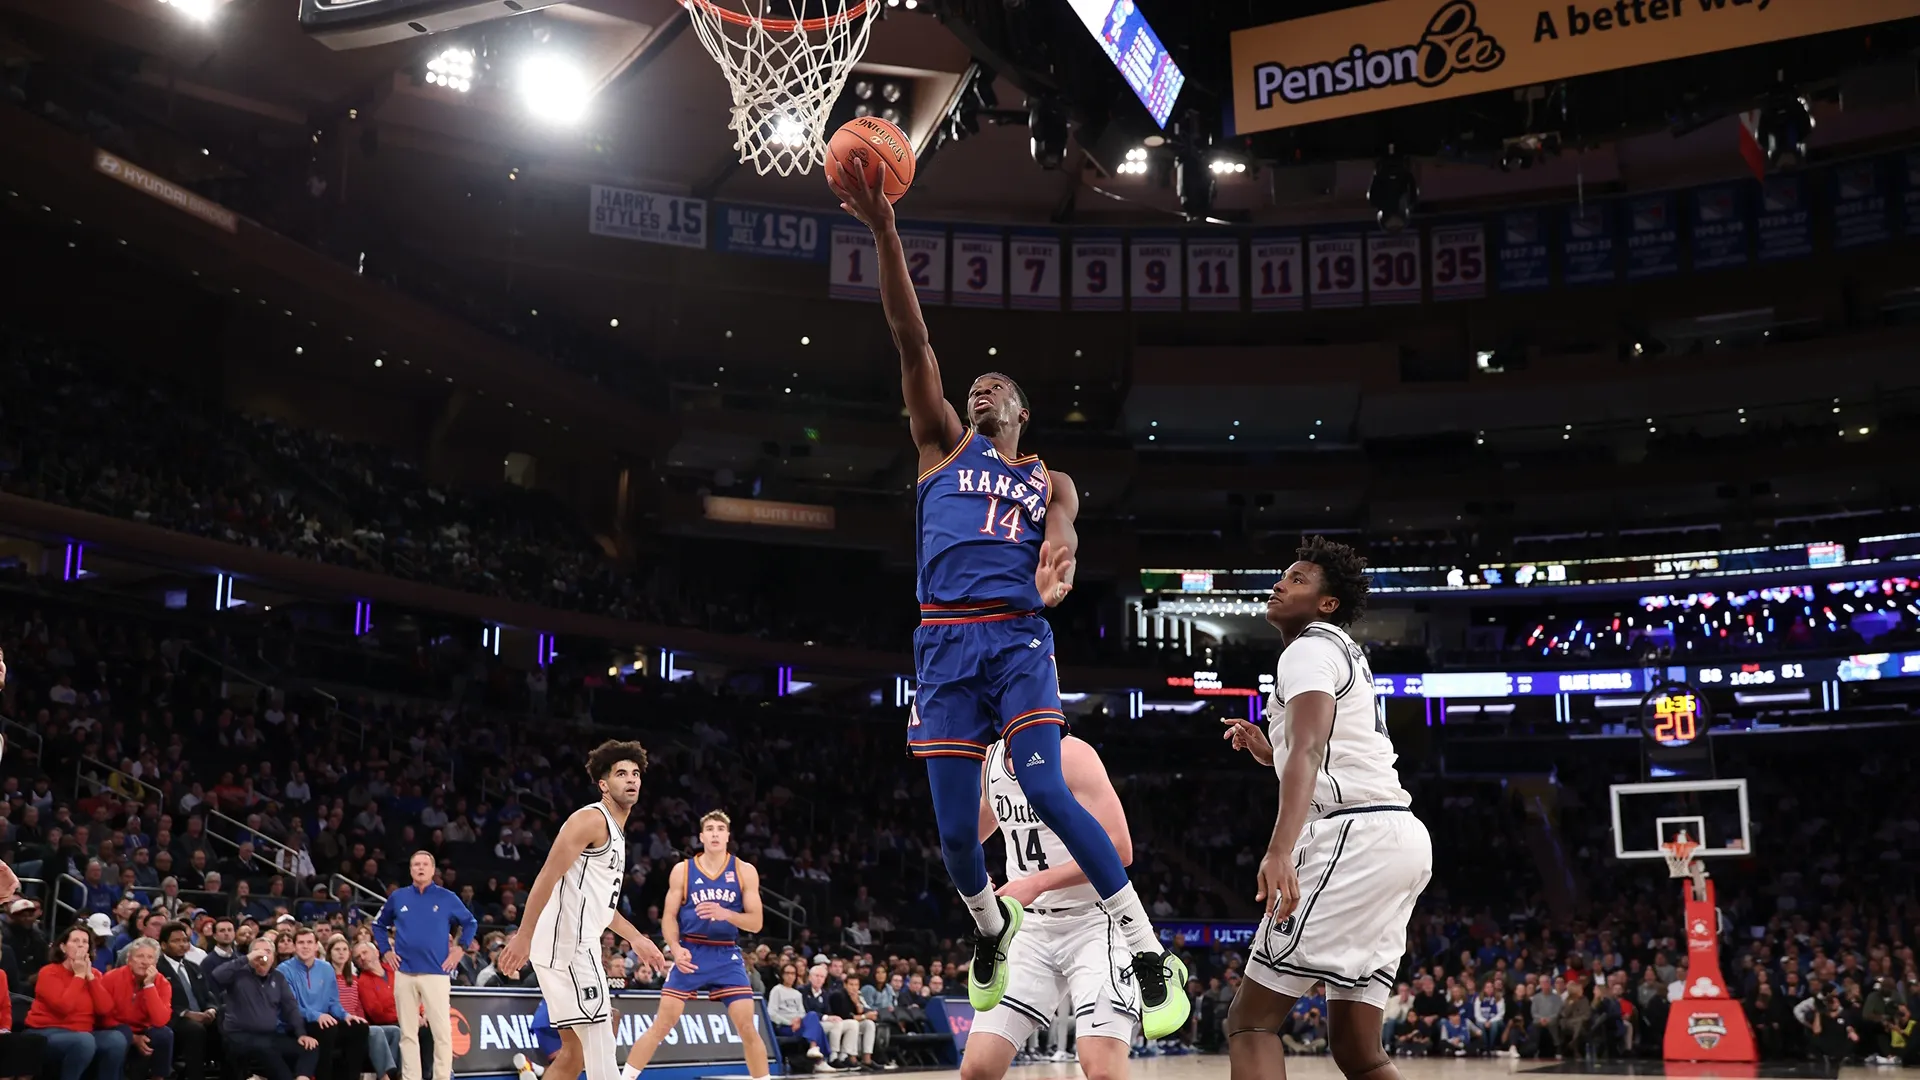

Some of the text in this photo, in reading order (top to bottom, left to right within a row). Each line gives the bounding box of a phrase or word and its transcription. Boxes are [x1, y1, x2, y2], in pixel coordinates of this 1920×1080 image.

[1533, 0, 1682, 43] A better
[1255, 1, 1504, 108] PensionBee
[856, 119, 906, 163] SPALDING
[124, 167, 187, 206] HYUNDAI
[600, 188, 656, 211] HARRY
[596, 206, 661, 230] STYLES
[667, 200, 701, 234] 15
[762, 213, 818, 251] 150
[848, 249, 863, 283] 1
[909, 252, 930, 286] 2
[967, 256, 988, 290] 3
[1024, 258, 1045, 293] 7
[1086, 260, 1107, 293] 9
[1145, 260, 1166, 293] 9
[1198, 260, 1230, 294] 11
[1261, 259, 1292, 294] 11
[1317, 255, 1356, 291] 19
[1372, 252, 1416, 287] 30
[1436, 246, 1482, 282] 35
[957, 469, 1046, 523] KANSAS
[979, 495, 1024, 543] 14
[1654, 558, 1719, 574] 15 YEARS
[1730, 670, 1776, 686] 10:36
[1781, 663, 1805, 678] 51
[1656, 695, 1696, 713] 10:36
[1654, 711, 1696, 742] 20
[995, 794, 1040, 824] Duk
[1011, 828, 1050, 872] 14
[691, 888, 736, 905] KANSAS
[679, 1014, 709, 1044] IN
